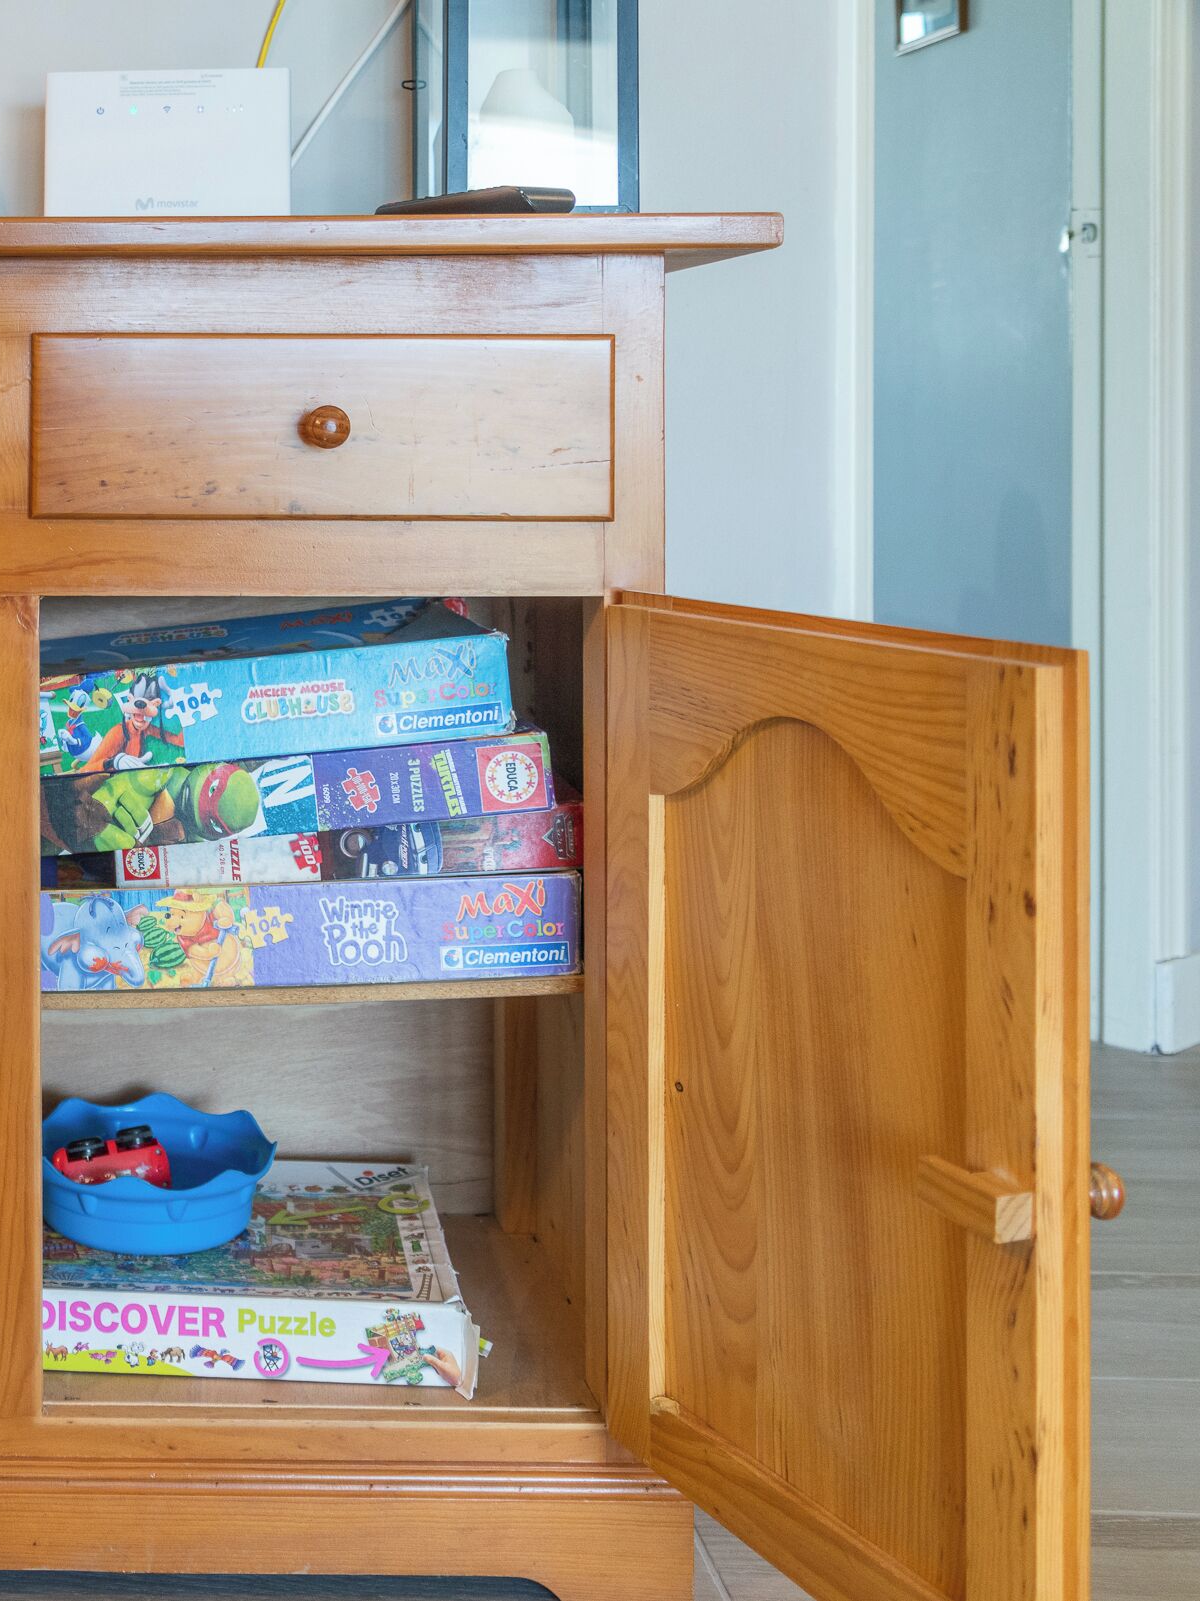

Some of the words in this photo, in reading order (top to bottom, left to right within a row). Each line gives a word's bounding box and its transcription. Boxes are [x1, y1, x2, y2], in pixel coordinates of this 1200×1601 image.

[157, 200, 200, 209] movistar
[176, 691, 212, 713] 104
[249, 686, 296, 699] MICKEY
[300, 681, 345, 694] MOUSE
[244, 693, 353, 721] CLUBHOUSE
[399, 706, 500, 731] Clementoni
[407, 758, 421, 766] 3
[434, 752, 463, 817] TURTLES
[505, 762, 519, 792] EDUCA
[408, 768, 425, 813] PUZZLES
[137, 853, 145, 870] EDUCA
[229, 839, 242, 882] UZZLE
[298, 838, 317, 866] 100
[321, 898, 397, 924] Winnie
[249, 916, 282, 935] 104
[350, 920, 378, 940] the
[323, 919, 406, 965] Pooh
[465, 945, 566, 966] Clementoni
[355, 1166, 410, 1187] Diset
[42, 1300, 227, 1338] DISCOVER
[237, 1307, 337, 1338] Puzzle
